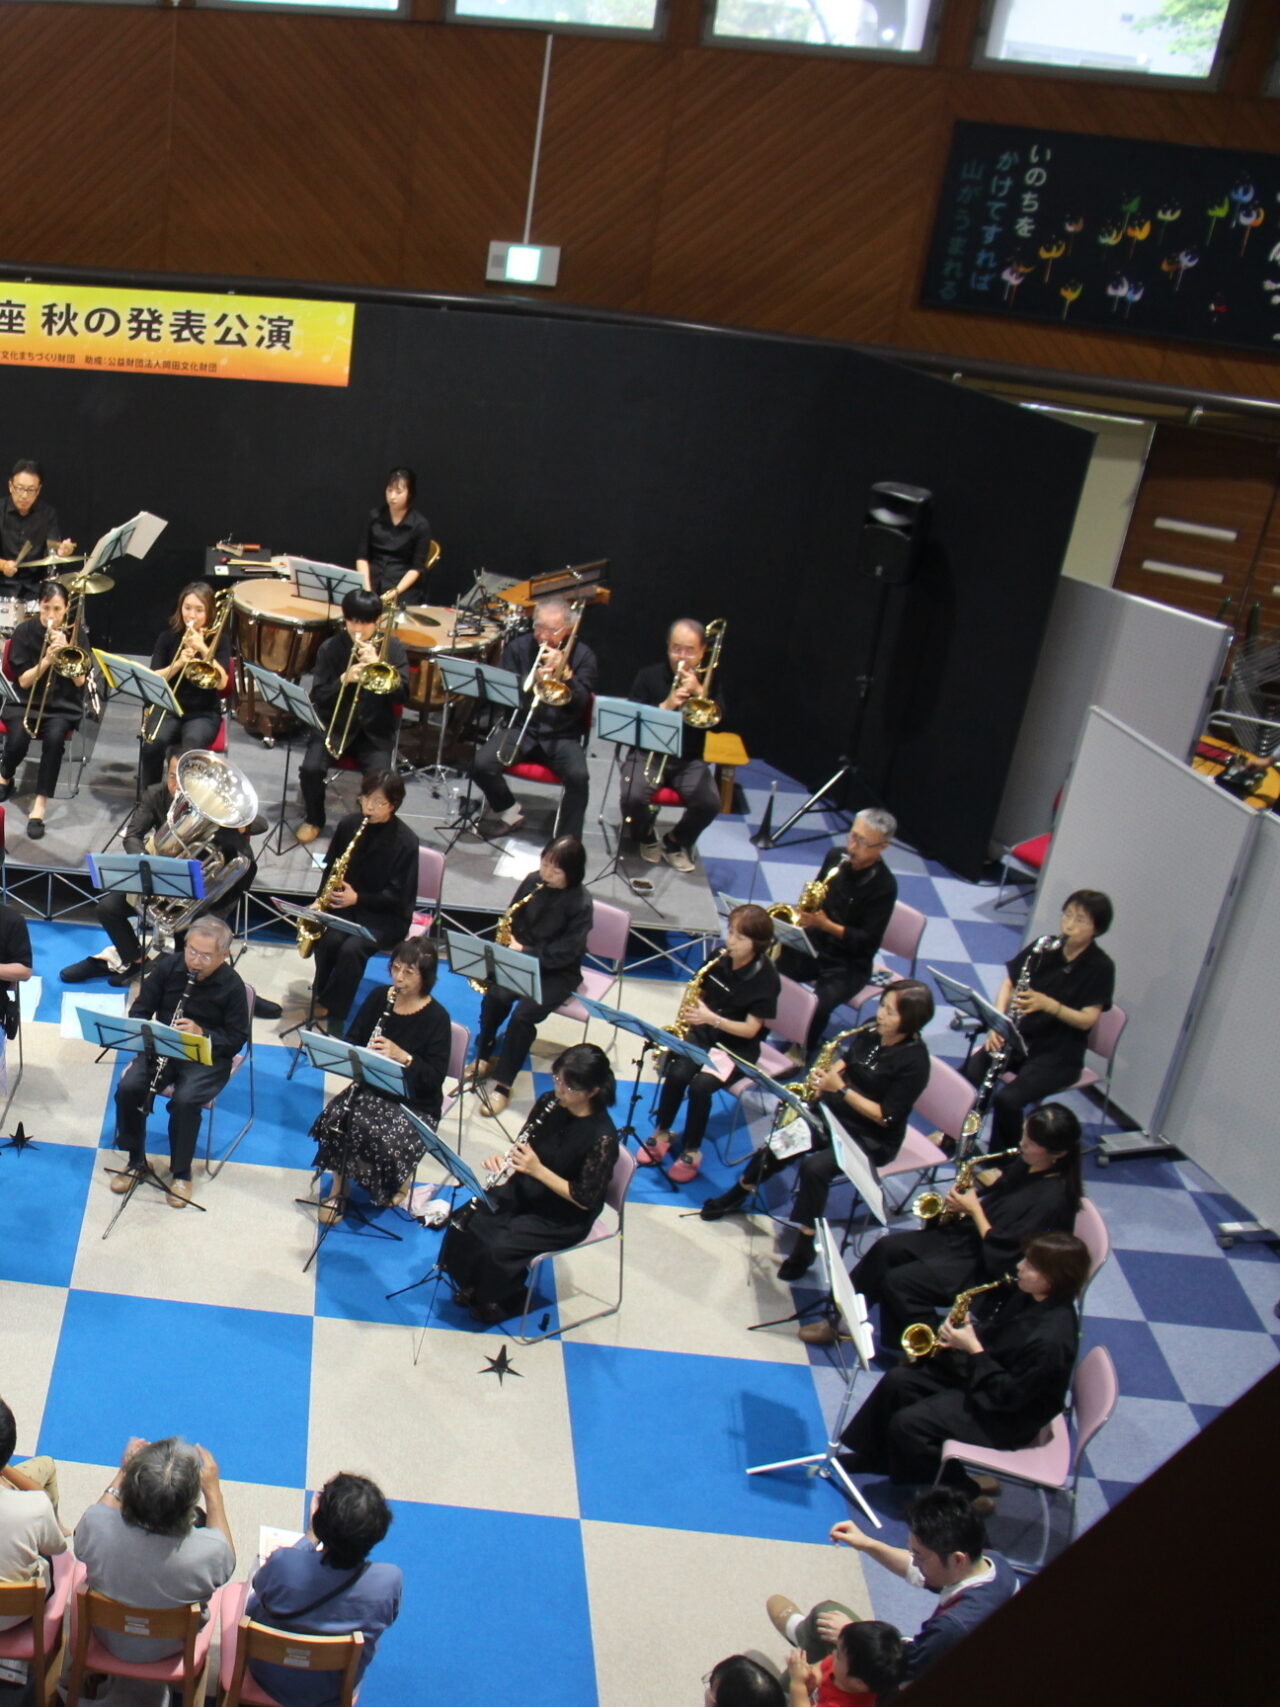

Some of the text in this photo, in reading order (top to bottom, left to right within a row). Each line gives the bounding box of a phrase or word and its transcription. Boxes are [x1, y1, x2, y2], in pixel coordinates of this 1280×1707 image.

[969, 150, 1020, 291] かけてすれば
[1014, 143, 1053, 239] いのちを
[40, 302, 295, 351] 秋の発表公演
